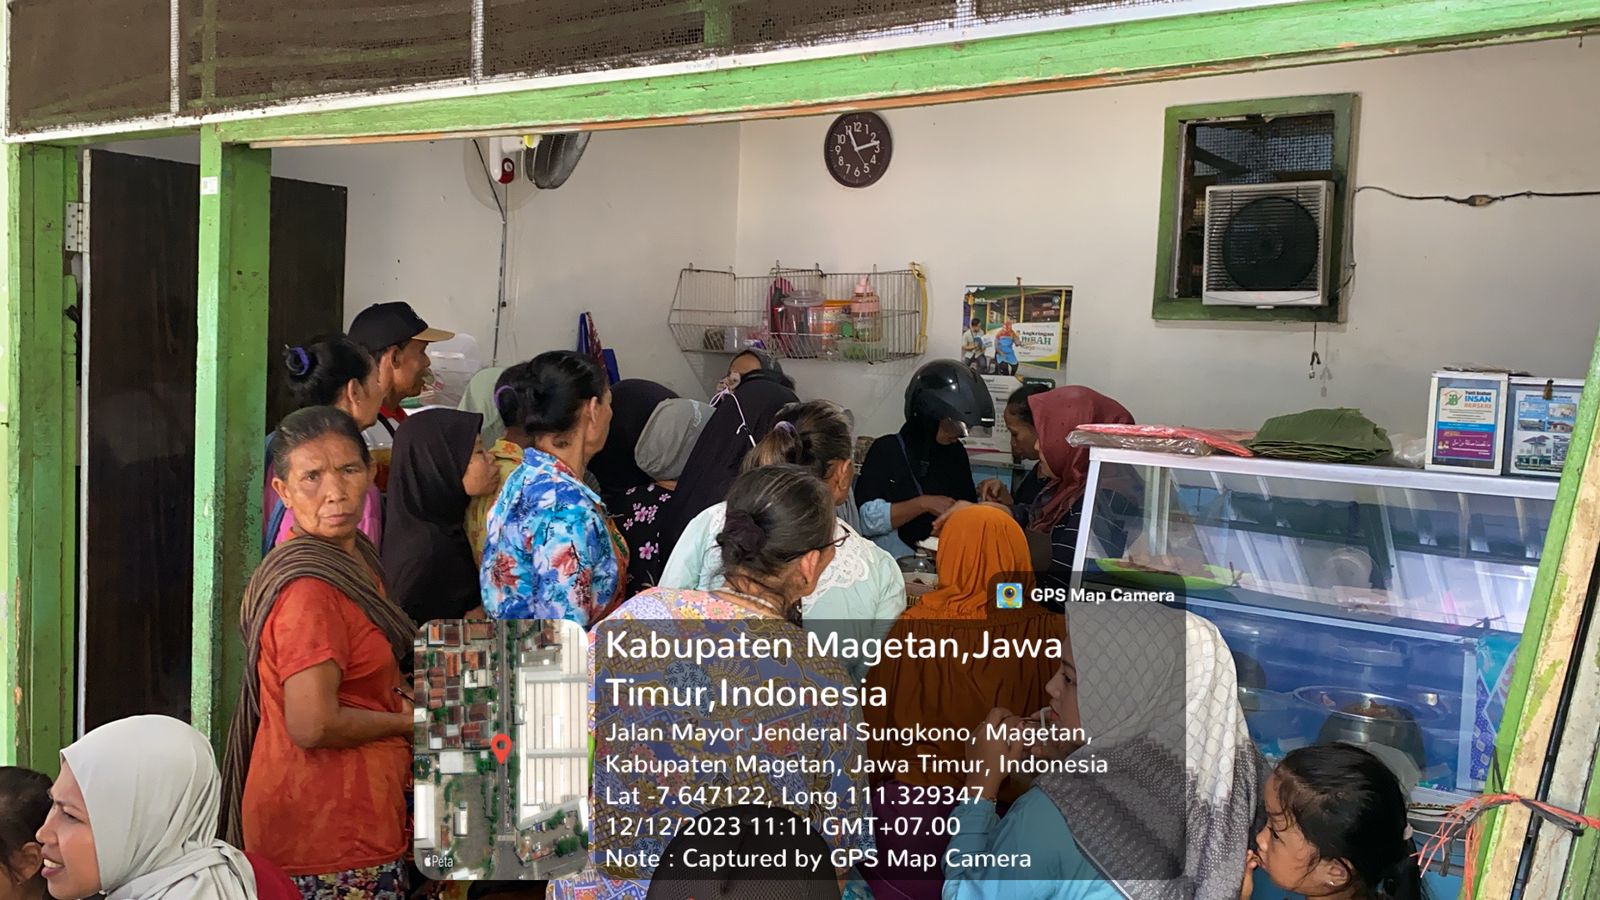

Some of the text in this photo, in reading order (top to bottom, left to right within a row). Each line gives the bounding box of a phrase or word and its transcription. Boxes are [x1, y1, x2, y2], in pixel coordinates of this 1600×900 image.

[853, 122, 862, 132] 12
[837, 134, 846, 144] 10
[871, 132, 877, 143] 2
[835, 145, 841, 155] 9
[874, 144, 880, 153] 3
[839, 156, 844, 165] 8
[870, 154, 876, 164] 4
[845, 164, 851, 174] 7
[854, 167, 860, 177] 6
[863, 163, 870, 173] 5
